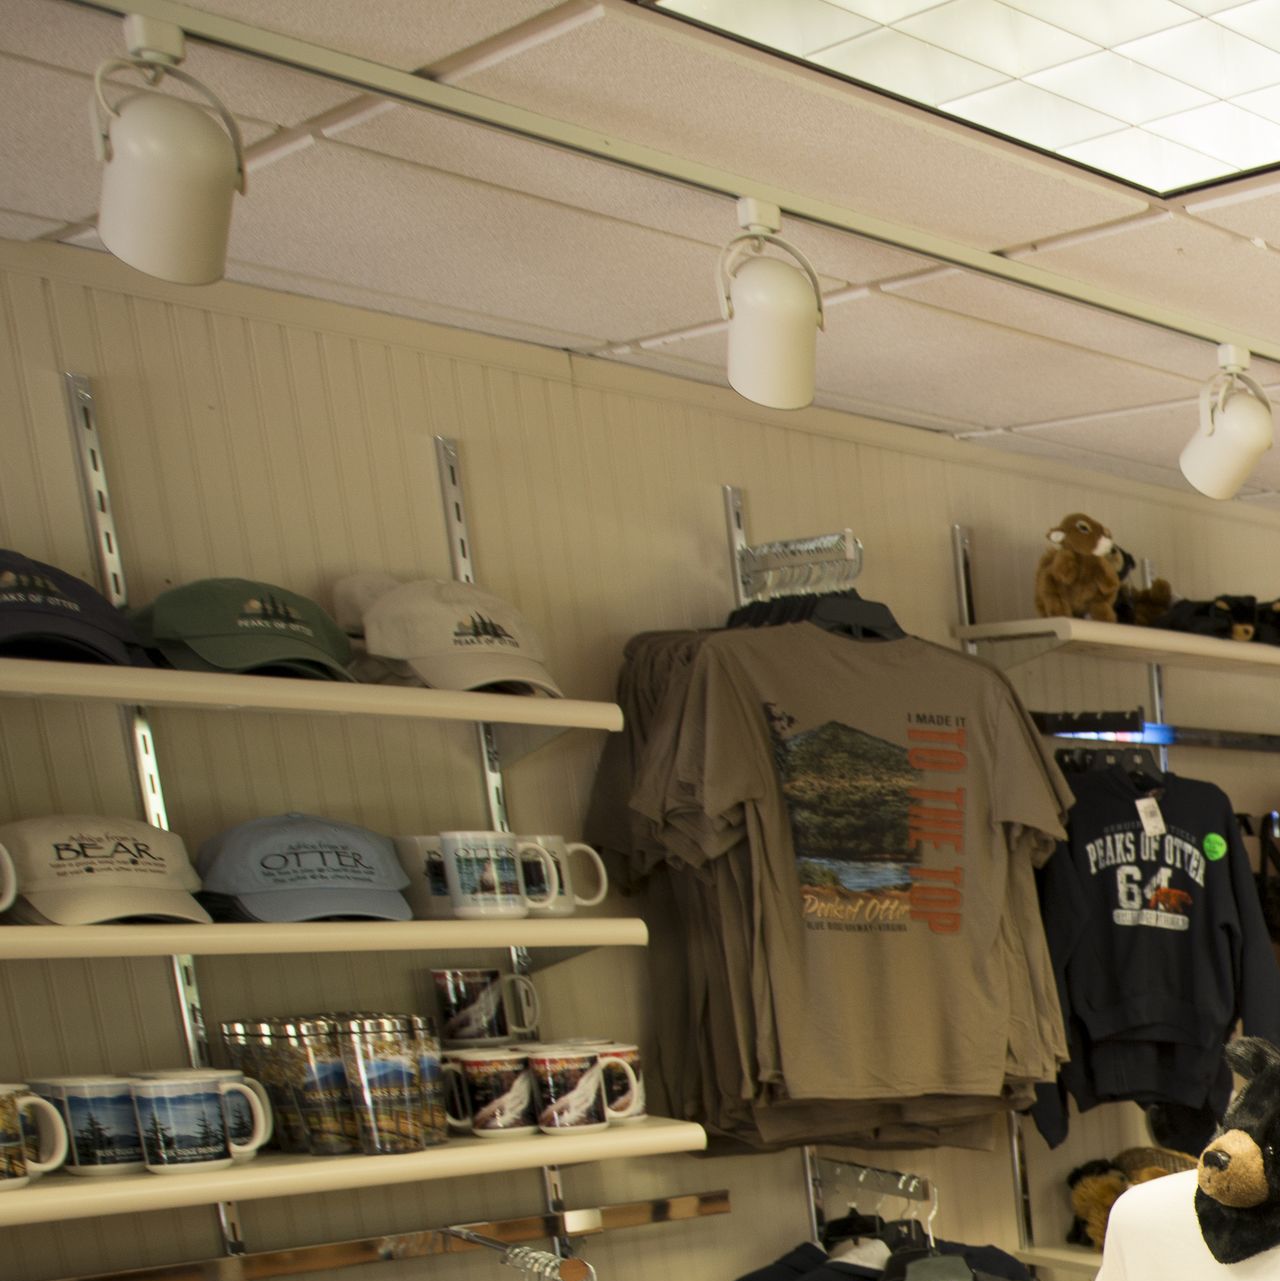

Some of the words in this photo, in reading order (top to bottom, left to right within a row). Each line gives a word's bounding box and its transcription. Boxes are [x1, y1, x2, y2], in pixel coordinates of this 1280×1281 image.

[915, 713, 951, 727] MADE
[955, 716, 967, 727] IT
[906, 728, 968, 772] TO
[906, 786, 967, 856] THE
[1103, 820, 1142, 833] GENUIN
[261, 849, 375, 870] OTTER
[1086, 831, 1136, 875] PEAKS
[1140, 832, 1160, 862] OF
[1164, 834, 1207, 888] OTTER
[908, 866, 962, 934] TOP
[1116, 864, 1173, 910] 64
